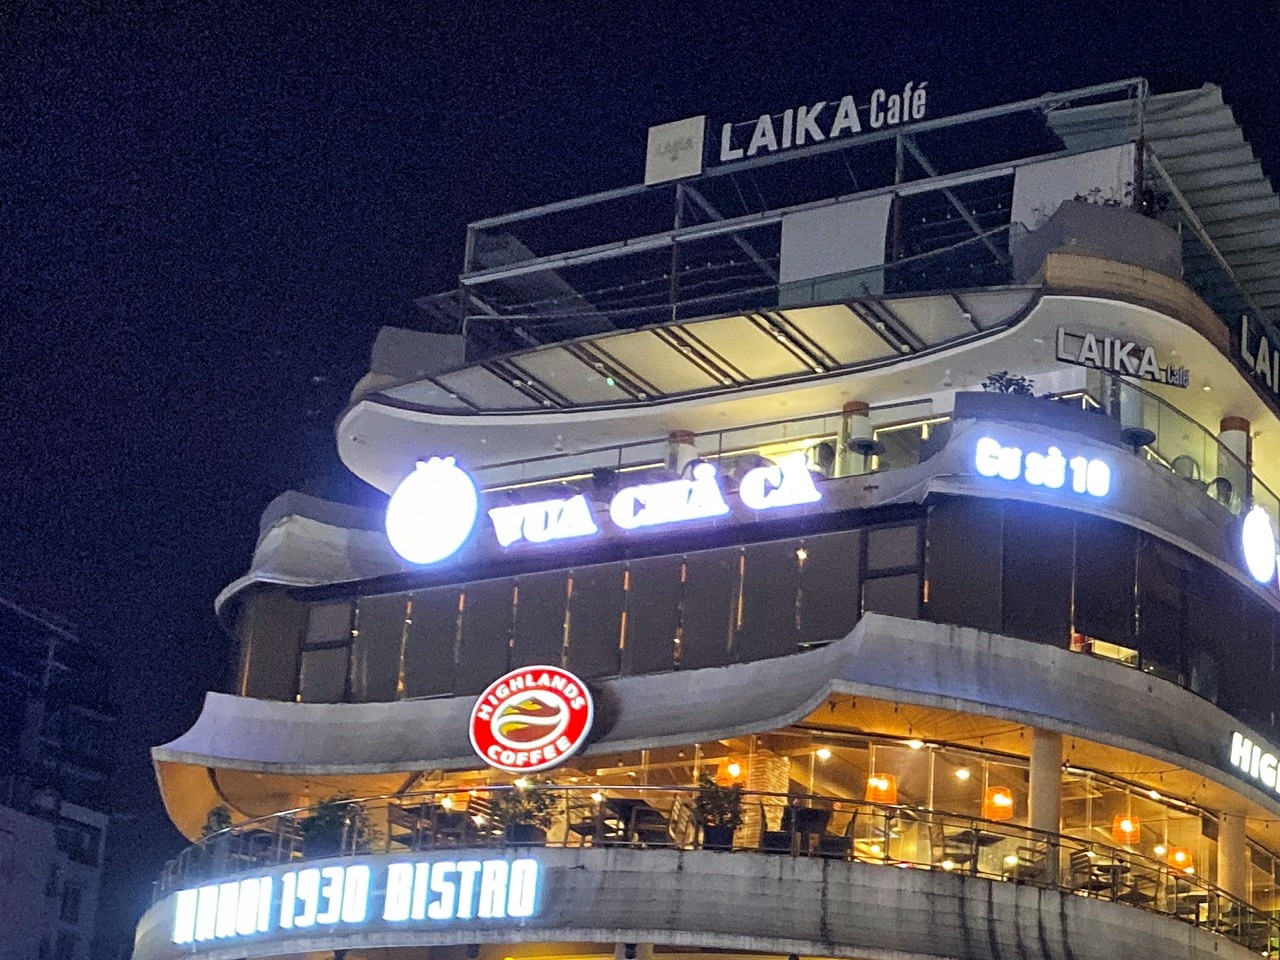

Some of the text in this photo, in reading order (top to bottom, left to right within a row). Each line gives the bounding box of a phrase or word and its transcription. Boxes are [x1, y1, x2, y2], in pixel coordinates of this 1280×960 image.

[719, 81, 929, 162] LAIKA Café
[1056, 326, 1162, 381] LAIKA
[477, 673, 587, 766] HIGHLANDS COFFEE
[280, 864, 370, 929] 1930
[383, 858, 539, 922] BISTRO
